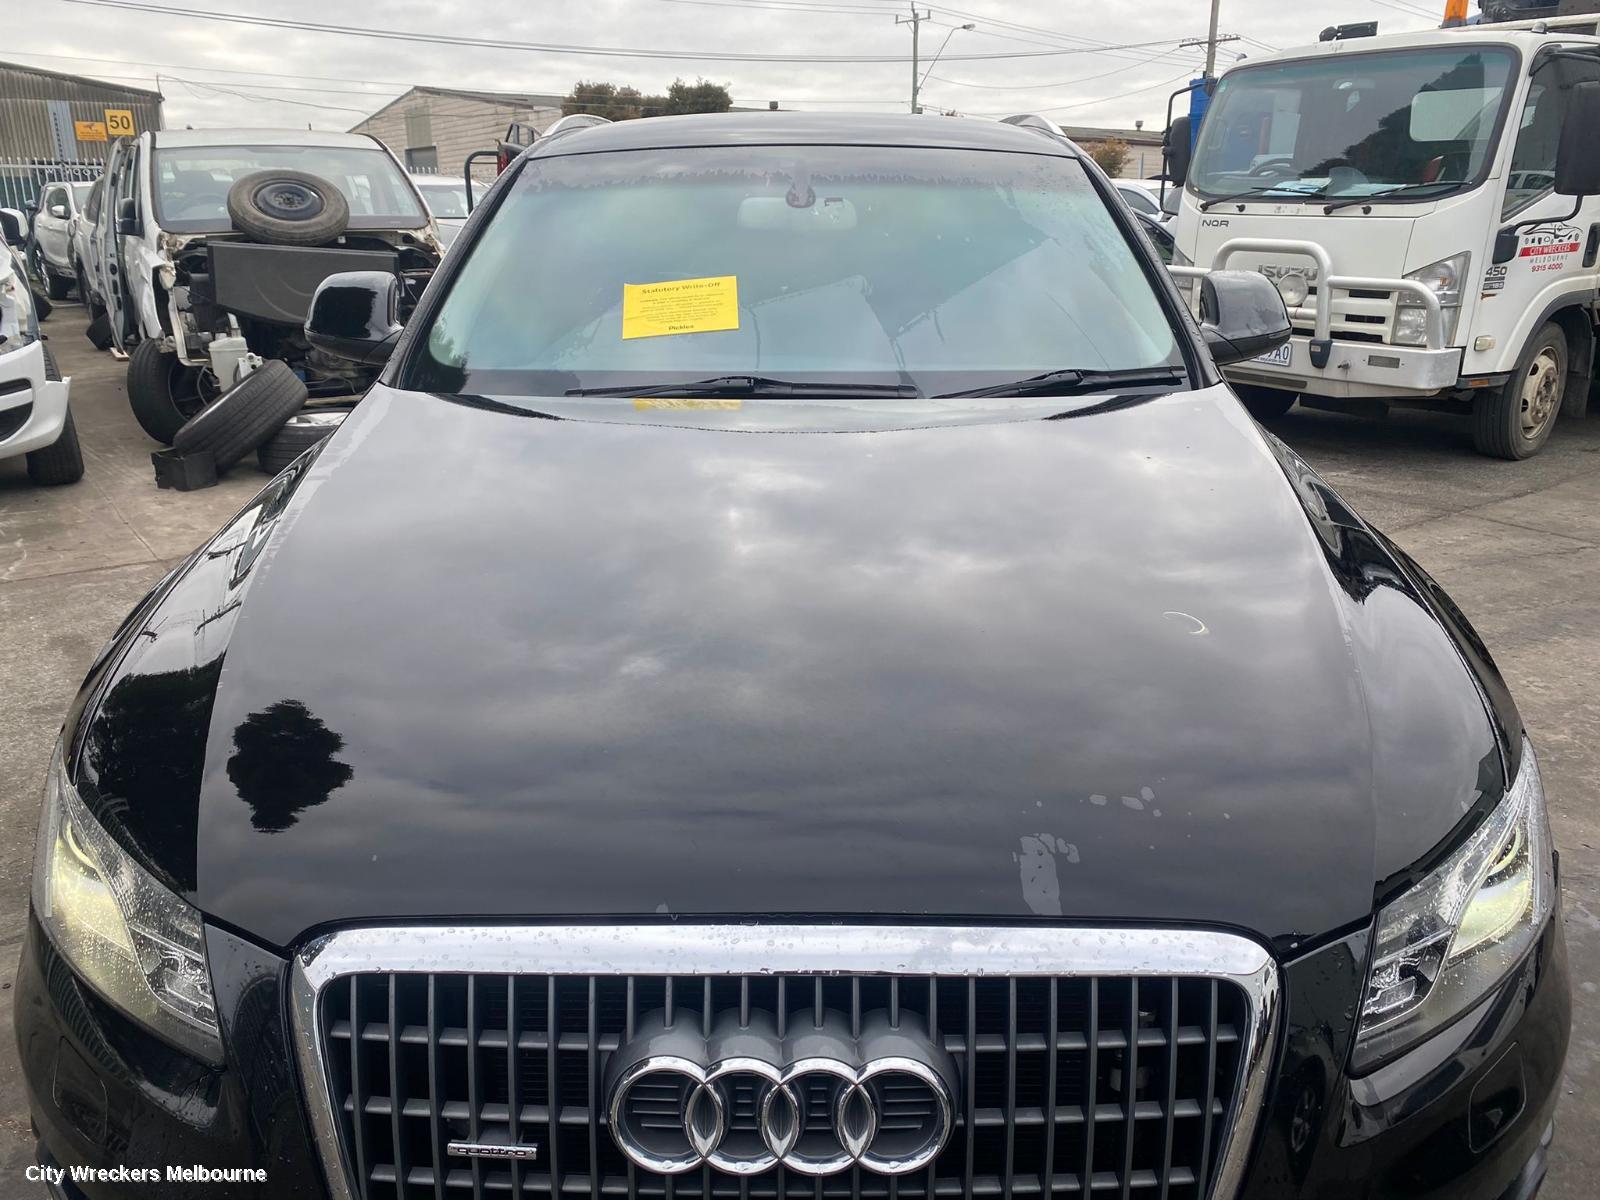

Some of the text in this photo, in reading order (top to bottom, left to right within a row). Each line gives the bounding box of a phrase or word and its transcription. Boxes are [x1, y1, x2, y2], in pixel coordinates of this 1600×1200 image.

[109, 115, 131, 130] 50
[1201, 219, 1230, 228] NQR
[1529, 243, 1572, 255] CITY WRECKERS
[1529, 254, 1569, 263] MELBOURNE
[1485, 266, 1508, 277] 450
[1531, 263, 1564, 272] 9315 4000
[641, 281, 721, 294] Statutory Write-Off
[457, 1147, 527, 1157] quattro
